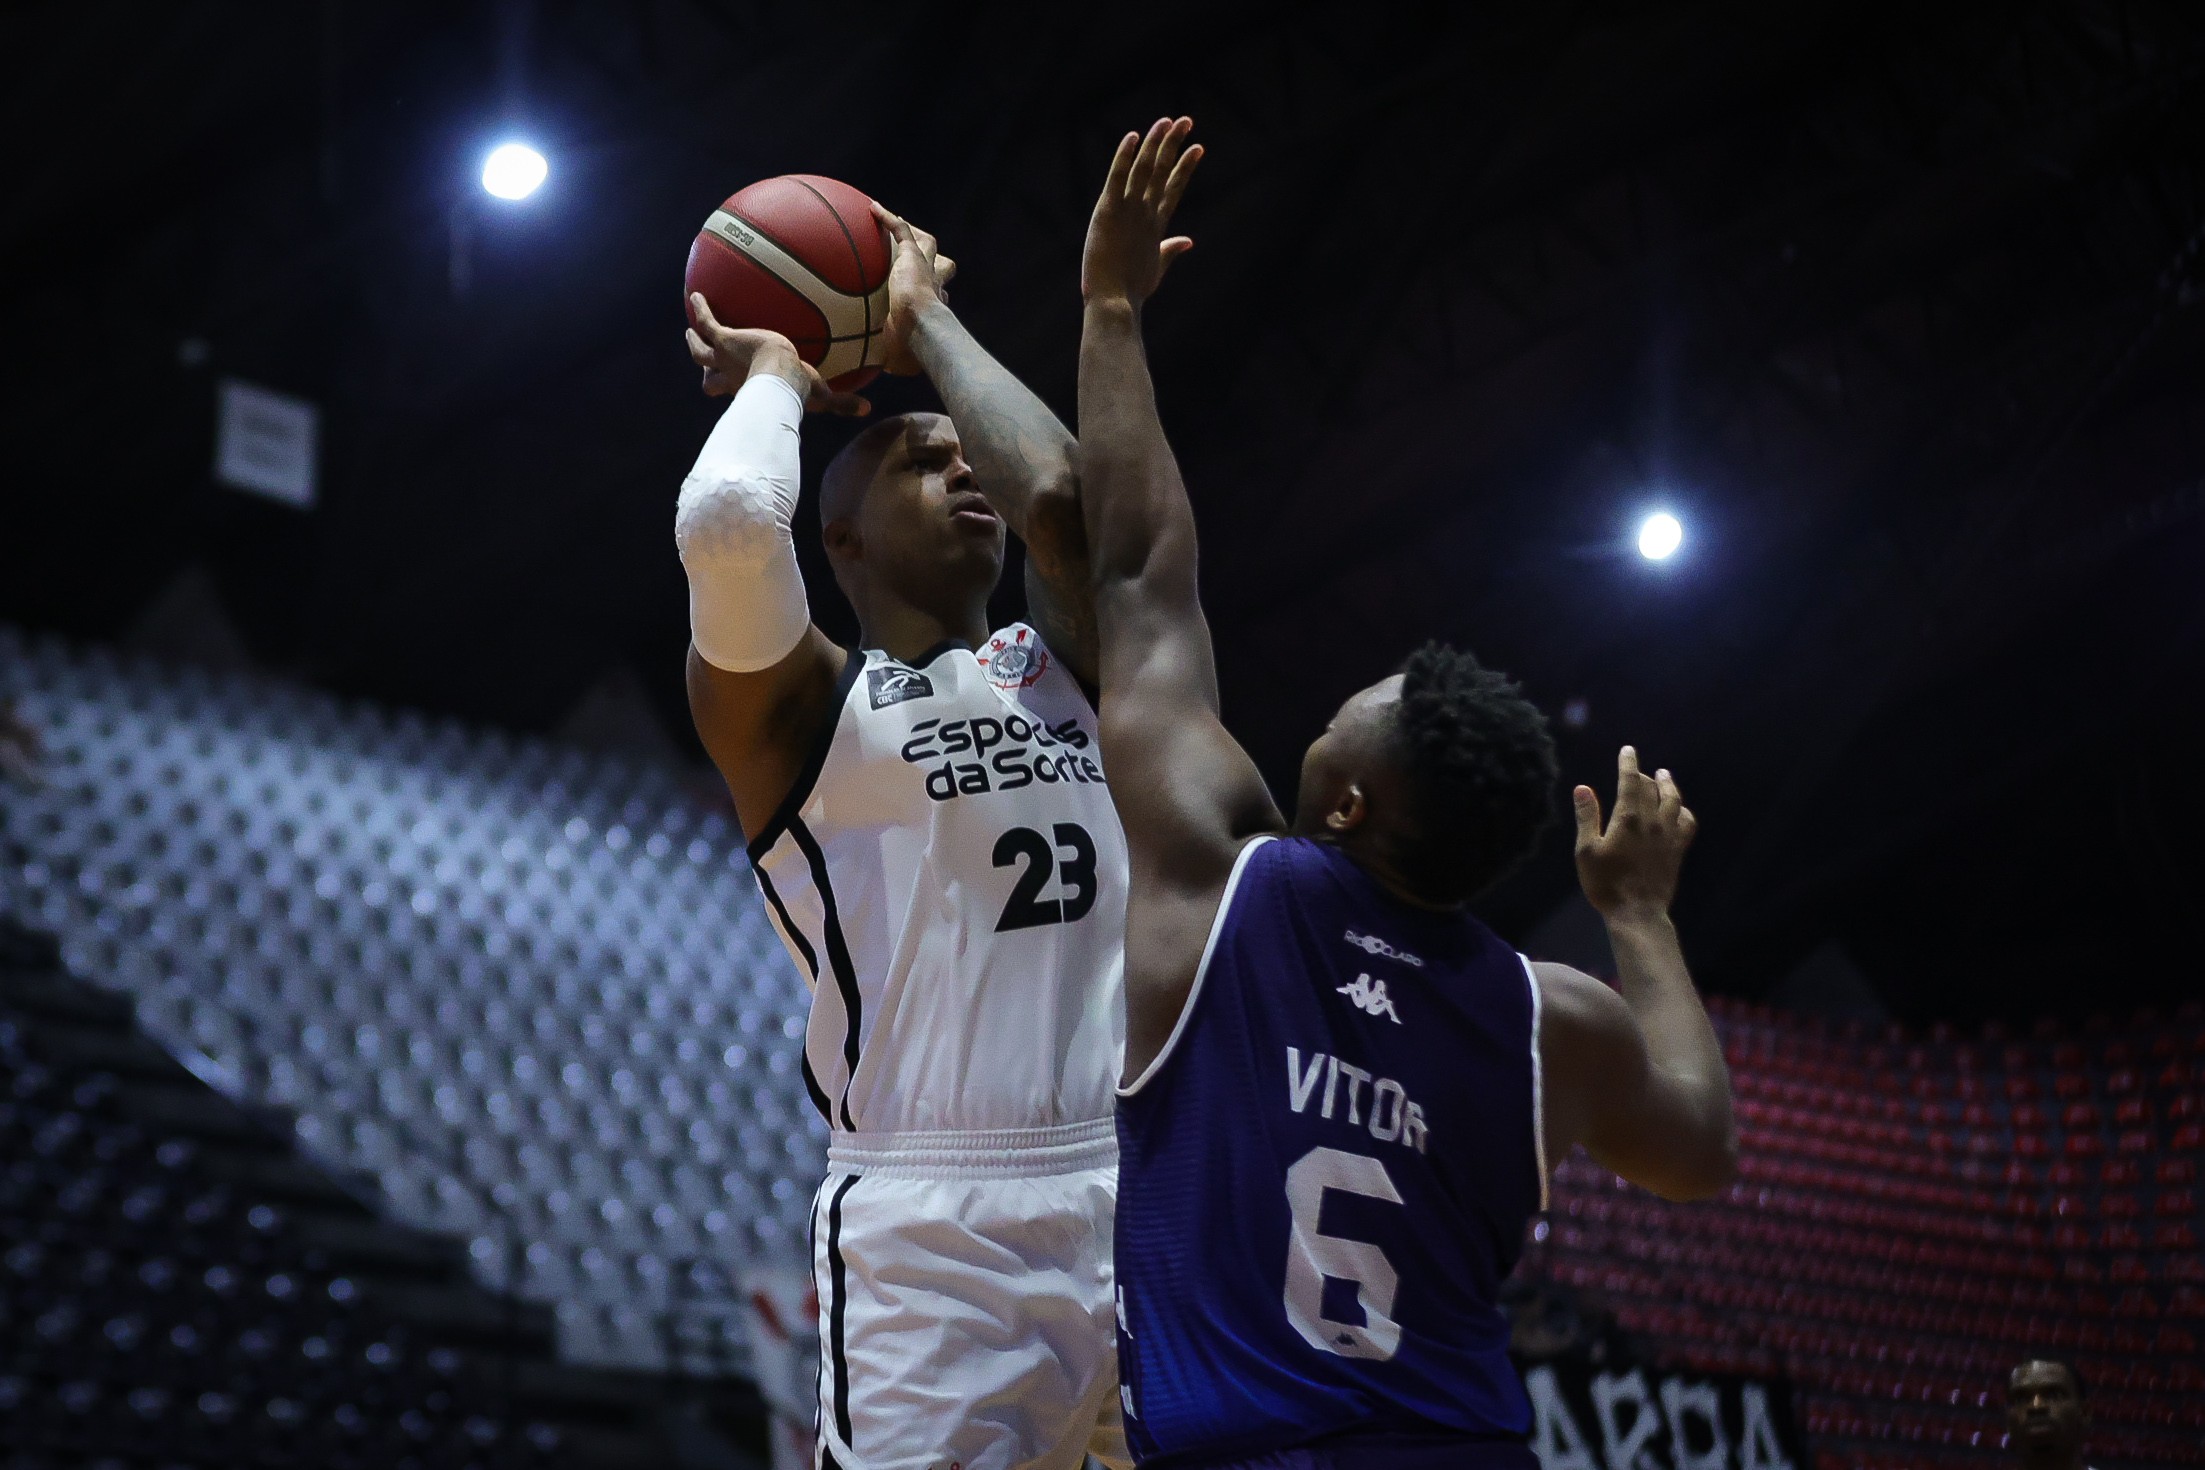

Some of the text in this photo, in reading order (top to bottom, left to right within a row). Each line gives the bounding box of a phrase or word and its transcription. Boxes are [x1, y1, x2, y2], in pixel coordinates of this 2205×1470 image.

[992, 822, 1097, 932] 23
[1286, 1046, 1428, 1155] VITOR
[1283, 1145, 1405, 1362] 6
